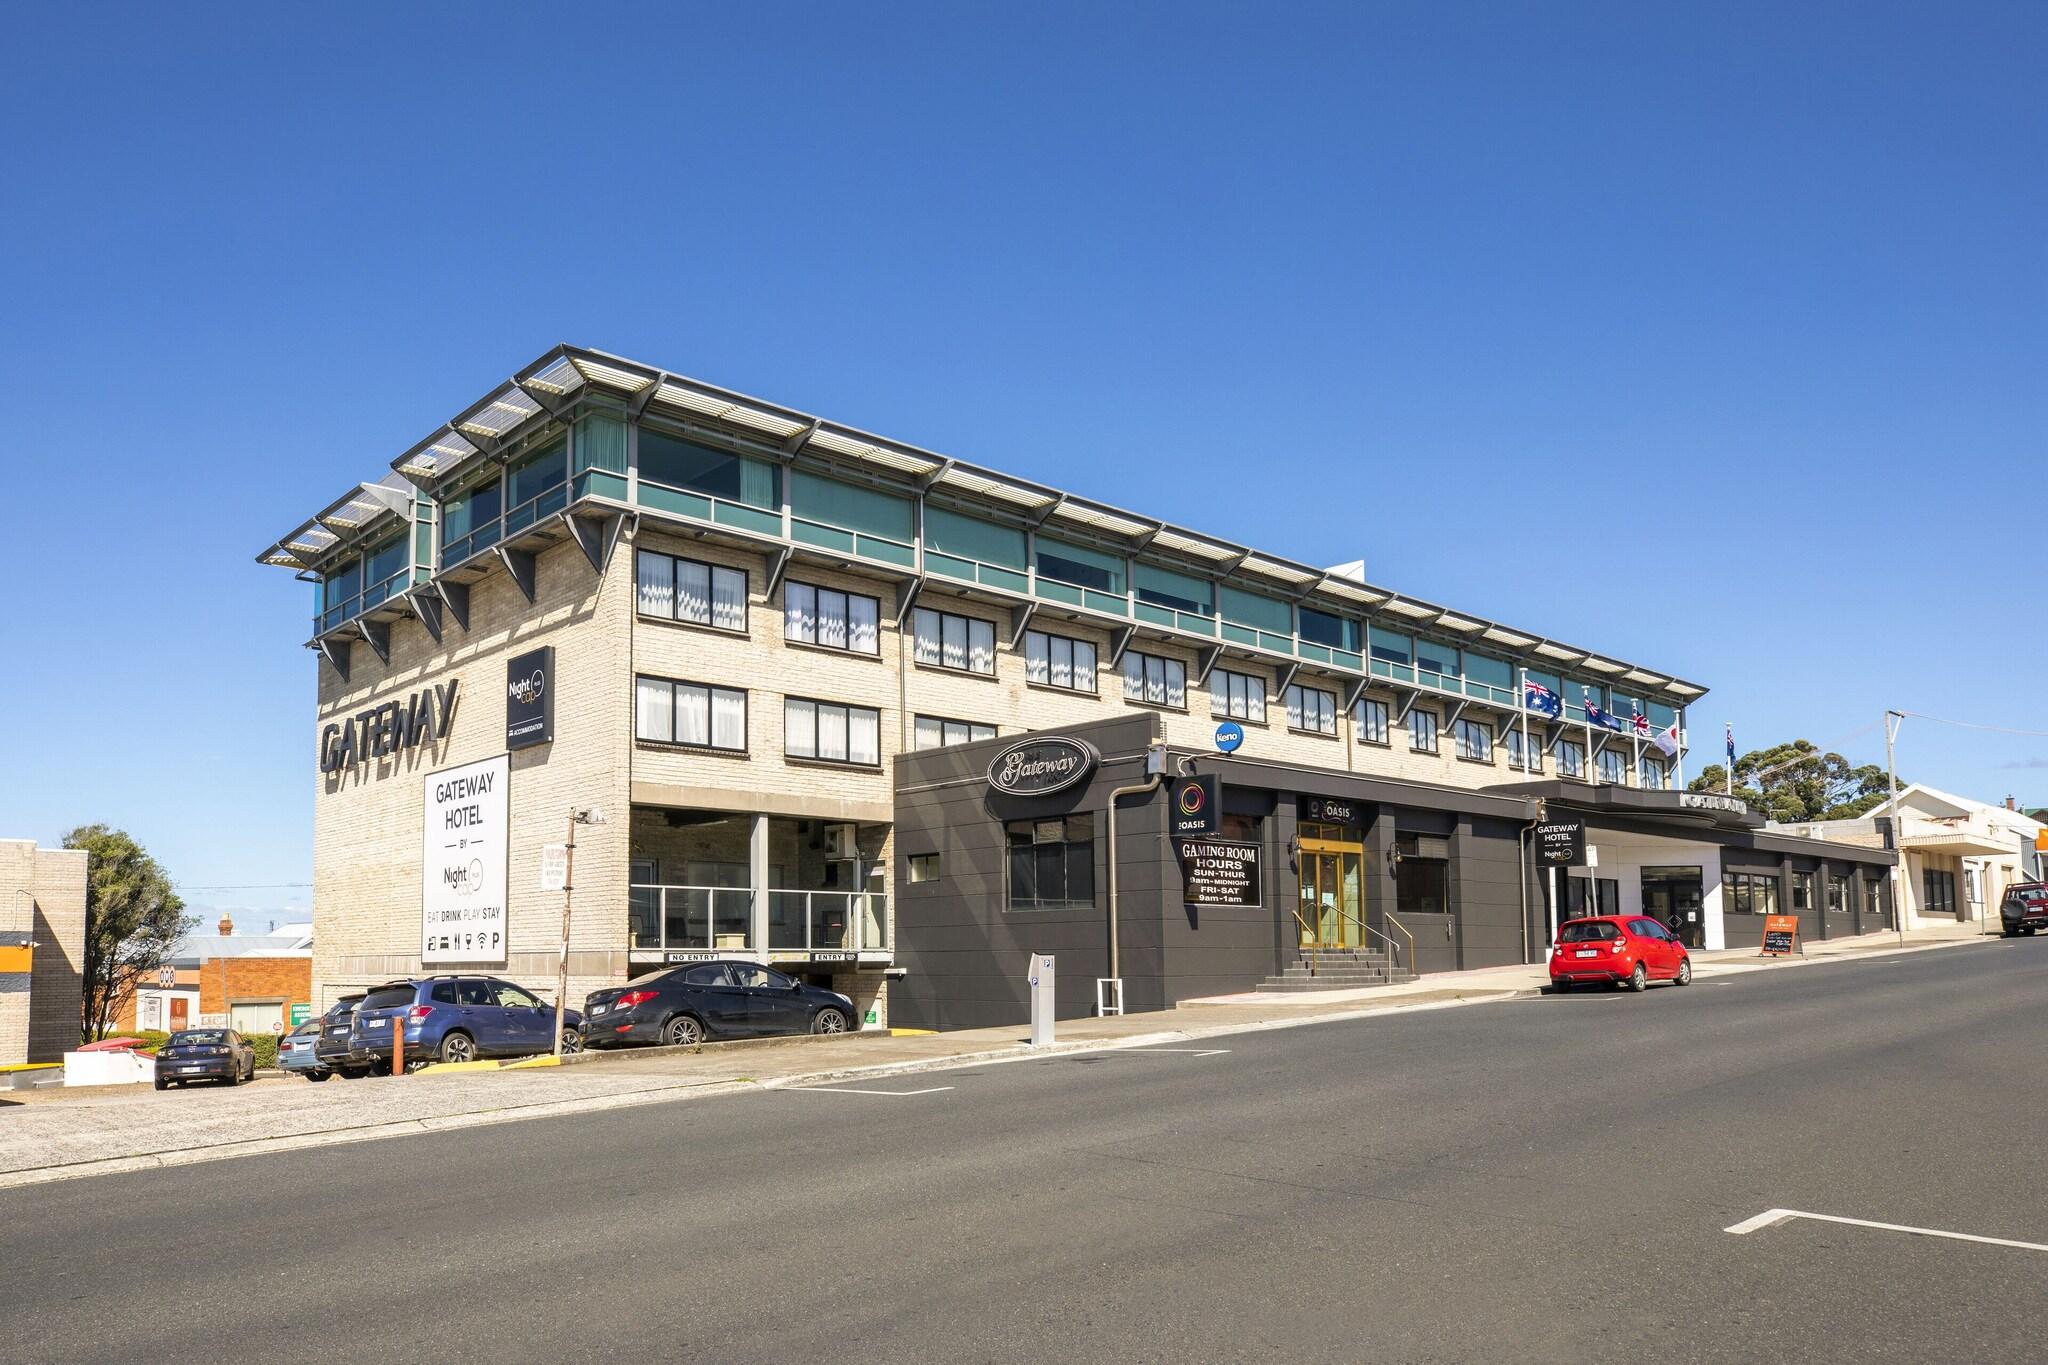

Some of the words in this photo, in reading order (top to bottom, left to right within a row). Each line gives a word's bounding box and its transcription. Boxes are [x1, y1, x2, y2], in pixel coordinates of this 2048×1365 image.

[509, 679, 530, 699] Night
[320, 679, 459, 773] GATEWAY
[999, 751, 1078, 787] Gateway
[436, 771, 494, 804] GATEWAY
[445, 804, 483, 830] HOTEL
[1326, 806, 1350, 818] OASIS
[1181, 820, 1205, 829] OASIS
[1537, 824, 1579, 834] GATEWAY
[460, 838, 467, 848] BY
[1544, 833, 1572, 841] HOTEL
[1182, 843, 1225, 858] GAMING
[1226, 848, 1256, 862] ROOM
[1544, 851, 1561, 859] Night
[1196, 858, 1243, 870] HOURS
[444, 866, 467, 889] Night
[1194, 869, 1246, 878] SUN-THUR
[1200, 886, 1240, 894] FRI-SAT
[1199, 894, 1242, 903] 9am-1am
[428, 911, 440, 923] EAT
[441, 909, 461, 922] DRINK
[463, 908, 480, 920] PLAY
[482, 907, 500, 920] STAY
[492, 932, 500, 950] P
